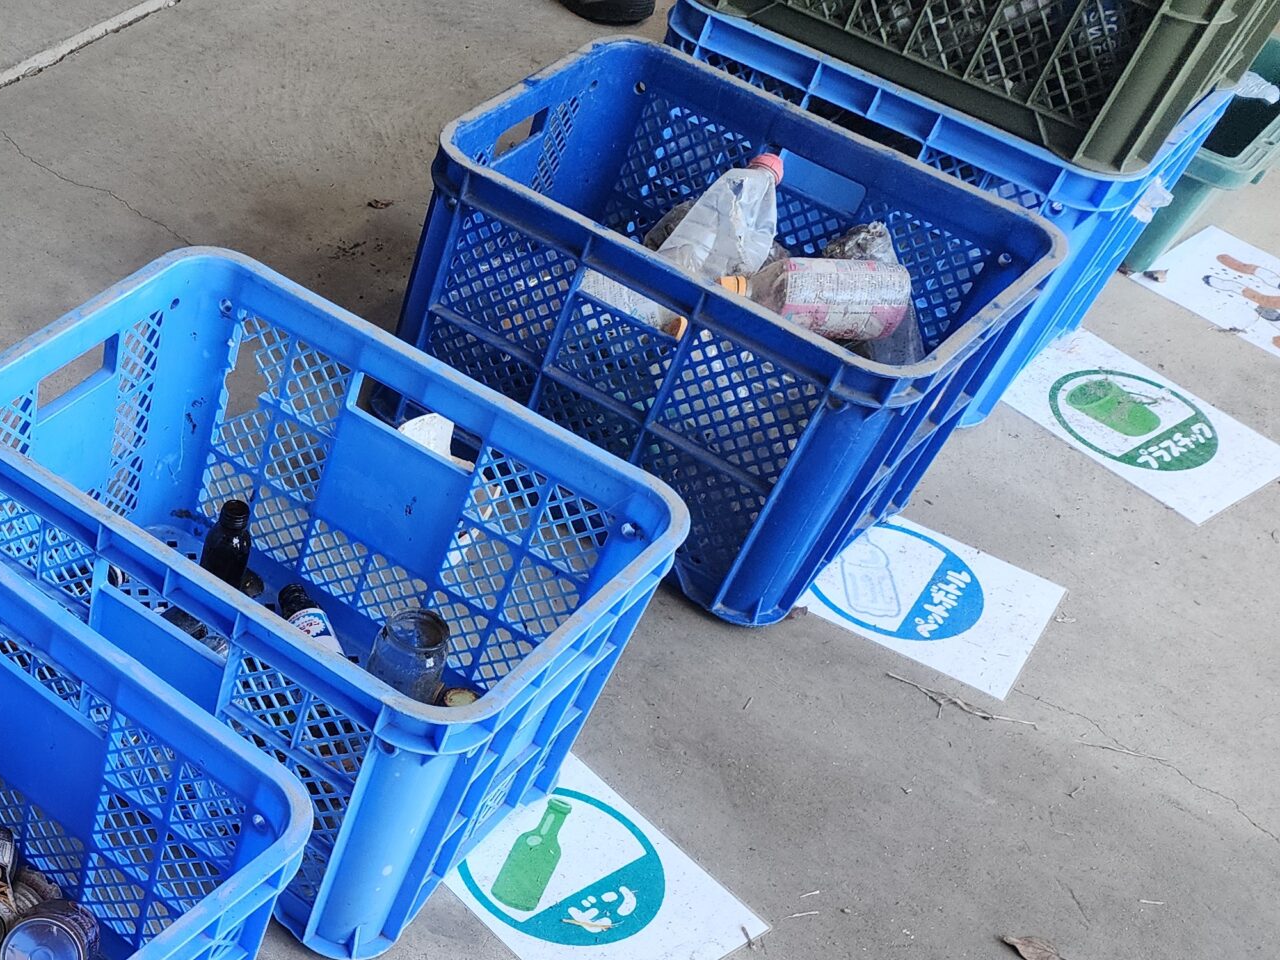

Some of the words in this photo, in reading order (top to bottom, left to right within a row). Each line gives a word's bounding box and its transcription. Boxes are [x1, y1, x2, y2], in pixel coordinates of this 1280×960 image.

[1136, 423, 1214, 469] プラスチック
[915, 570, 971, 638] ペットボトル
[567, 885, 638, 934] ビン
